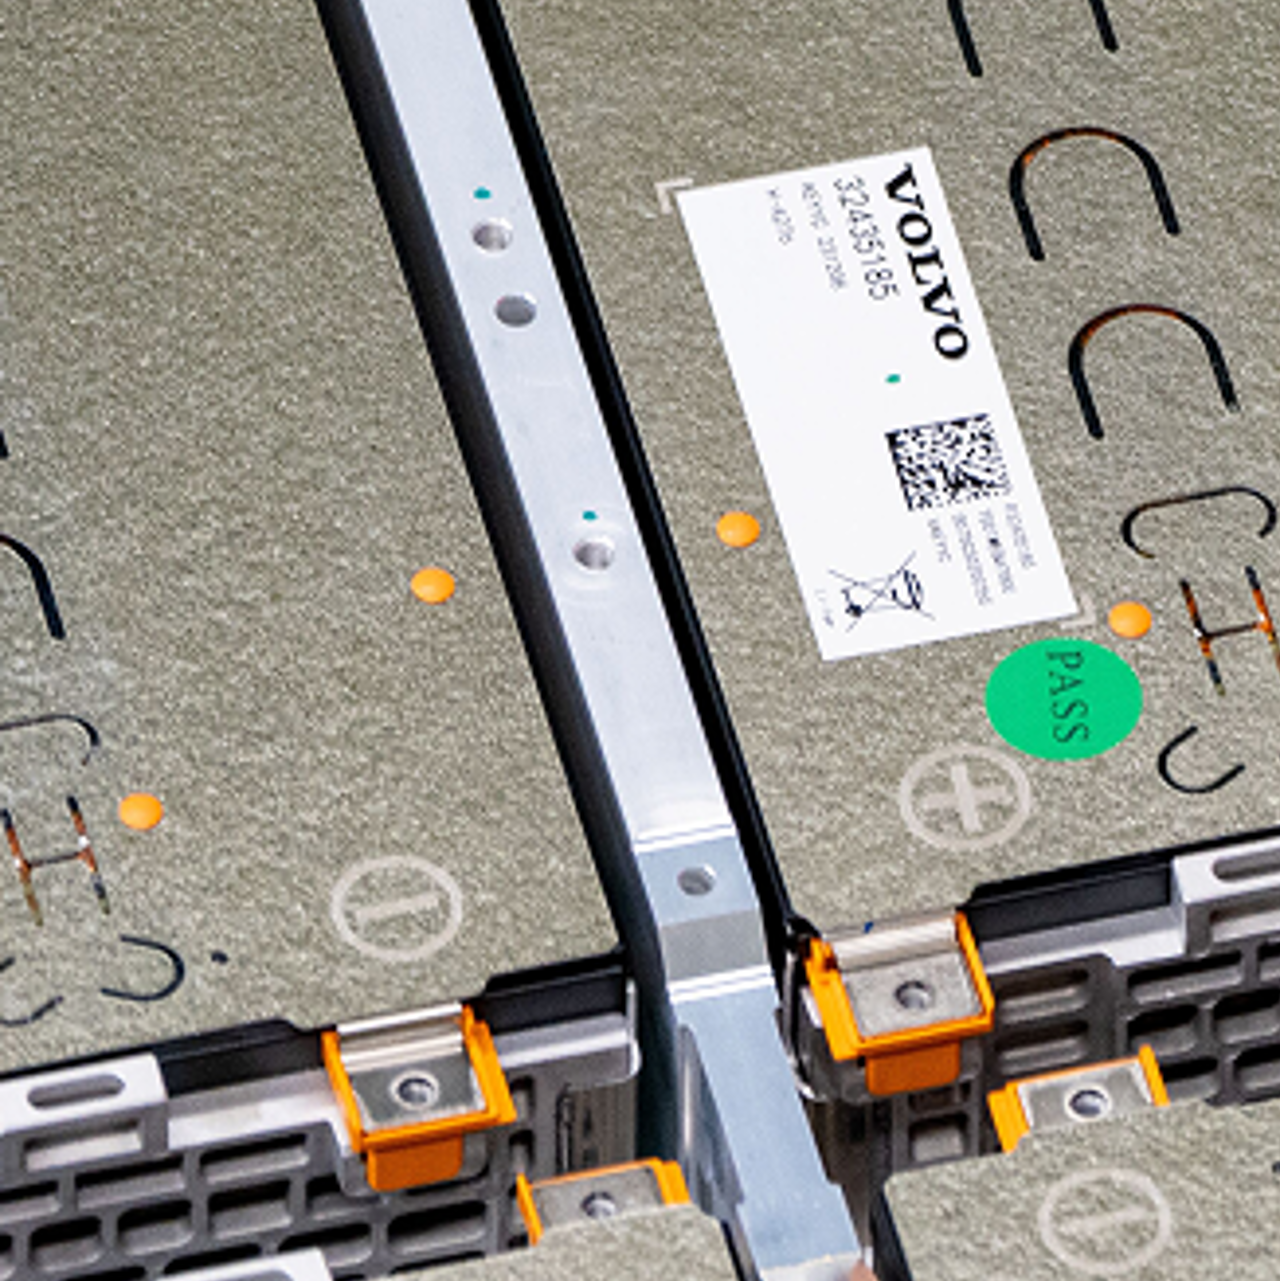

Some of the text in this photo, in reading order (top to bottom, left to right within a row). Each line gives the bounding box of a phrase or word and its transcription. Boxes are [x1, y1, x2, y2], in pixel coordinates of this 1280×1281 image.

[831, 174, 901, 303] 32435185
[884, 163, 969, 360] VOLVO
[1047, 651, 1090, 744] PASS
